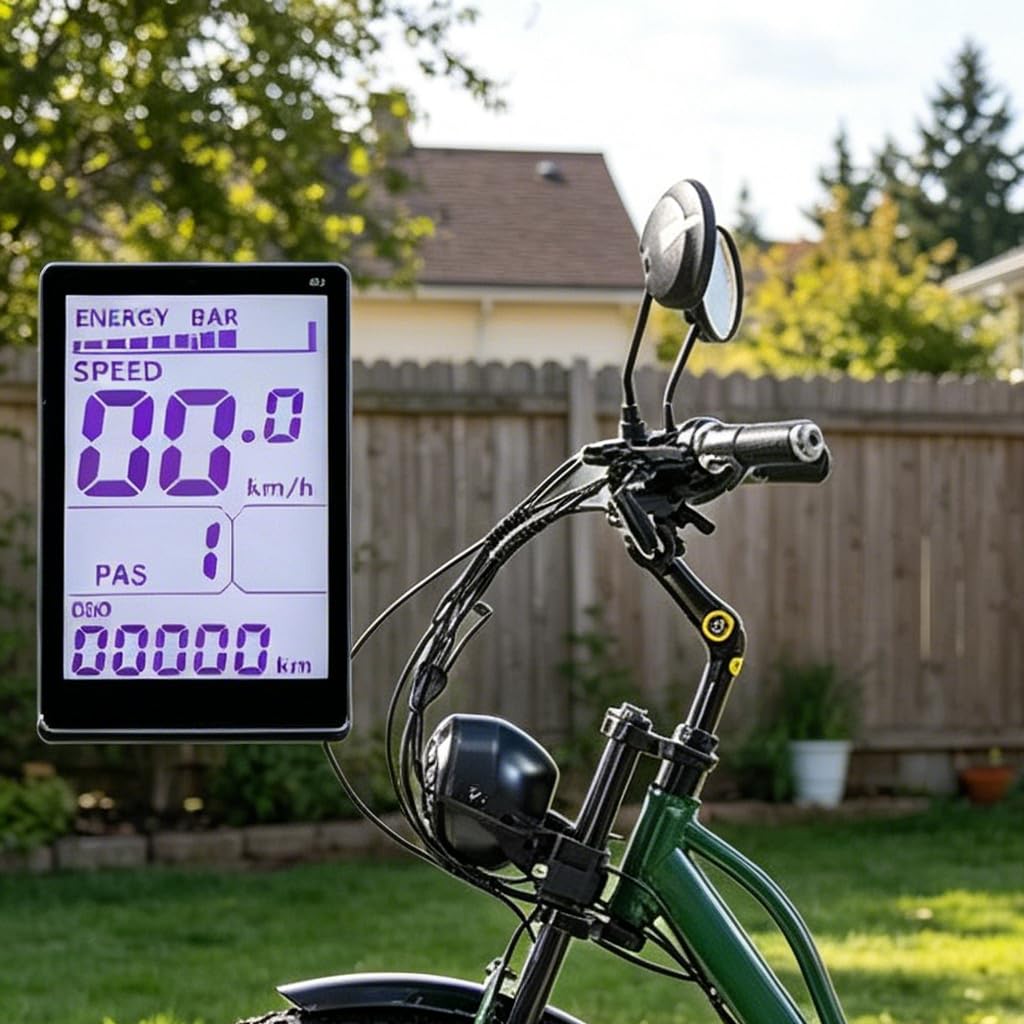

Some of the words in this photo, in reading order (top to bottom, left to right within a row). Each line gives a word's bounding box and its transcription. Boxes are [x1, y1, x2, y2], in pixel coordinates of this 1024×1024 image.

[76, 308, 169, 327] ENERGY
[191, 308, 238, 327] BAR
[73, 361, 163, 382] SPEED
[247, 476, 313, 499] km/h
[95, 564, 148, 586] PAS
[203, 522, 220, 580] 1
[72, 624, 270, 676] 00000
[276, 655, 312, 674] km
